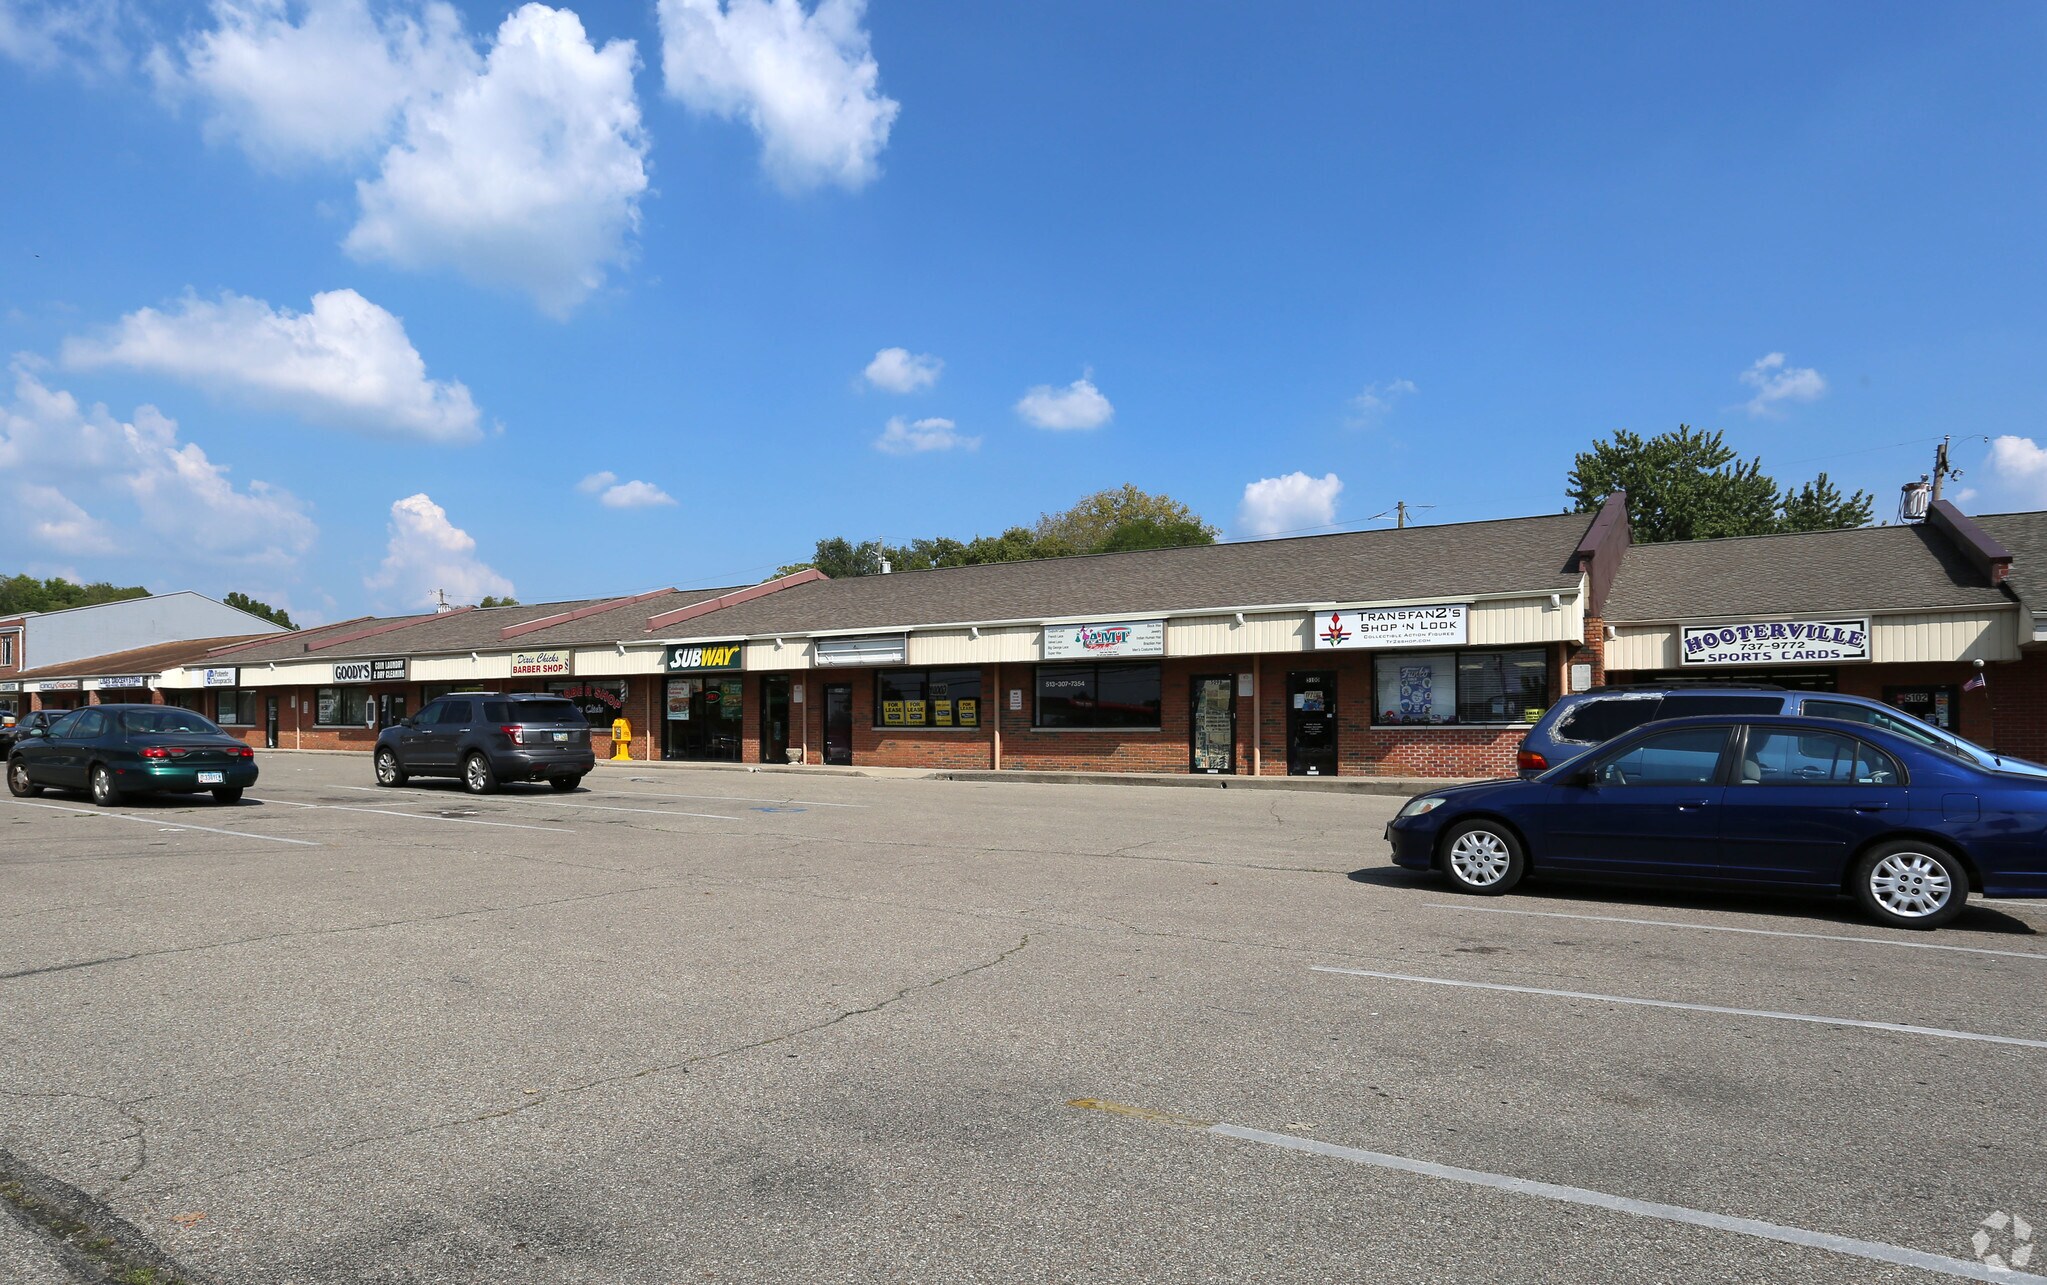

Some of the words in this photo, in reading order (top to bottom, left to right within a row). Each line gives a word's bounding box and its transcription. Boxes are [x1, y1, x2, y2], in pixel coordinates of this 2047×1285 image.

[1357, 607, 1461, 622] TRANSFAN2'S
[1361, 623, 1398, 633] SHOP
[1420, 621, 1458, 630] LOOK
[1089, 630, 1129, 644] AMT
[1685, 623, 1867, 654] HOOTERVILLE
[1740, 641, 1806, 651] 737-9772
[517, 654, 535, 664] Dixie
[536, 652, 559, 663] Chicks
[669, 644, 740, 669] SUBWAY
[1708, 652, 1773, 663] SPORTS
[1781, 649, 1841, 660] CARDS
[374, 661, 384, 670] COIN
[385, 660, 404, 669] LAUNDRY
[513, 665, 541, 673] BARBER
[542, 664, 564, 672] SHOP
[377, 670, 385, 679] DRY
[385, 669, 405, 679] CLEANING
[1045, 680, 1086, 688] 513-307-7354
[593, 686, 622, 710] SHOP
[1905, 694, 1928, 702] 5102
